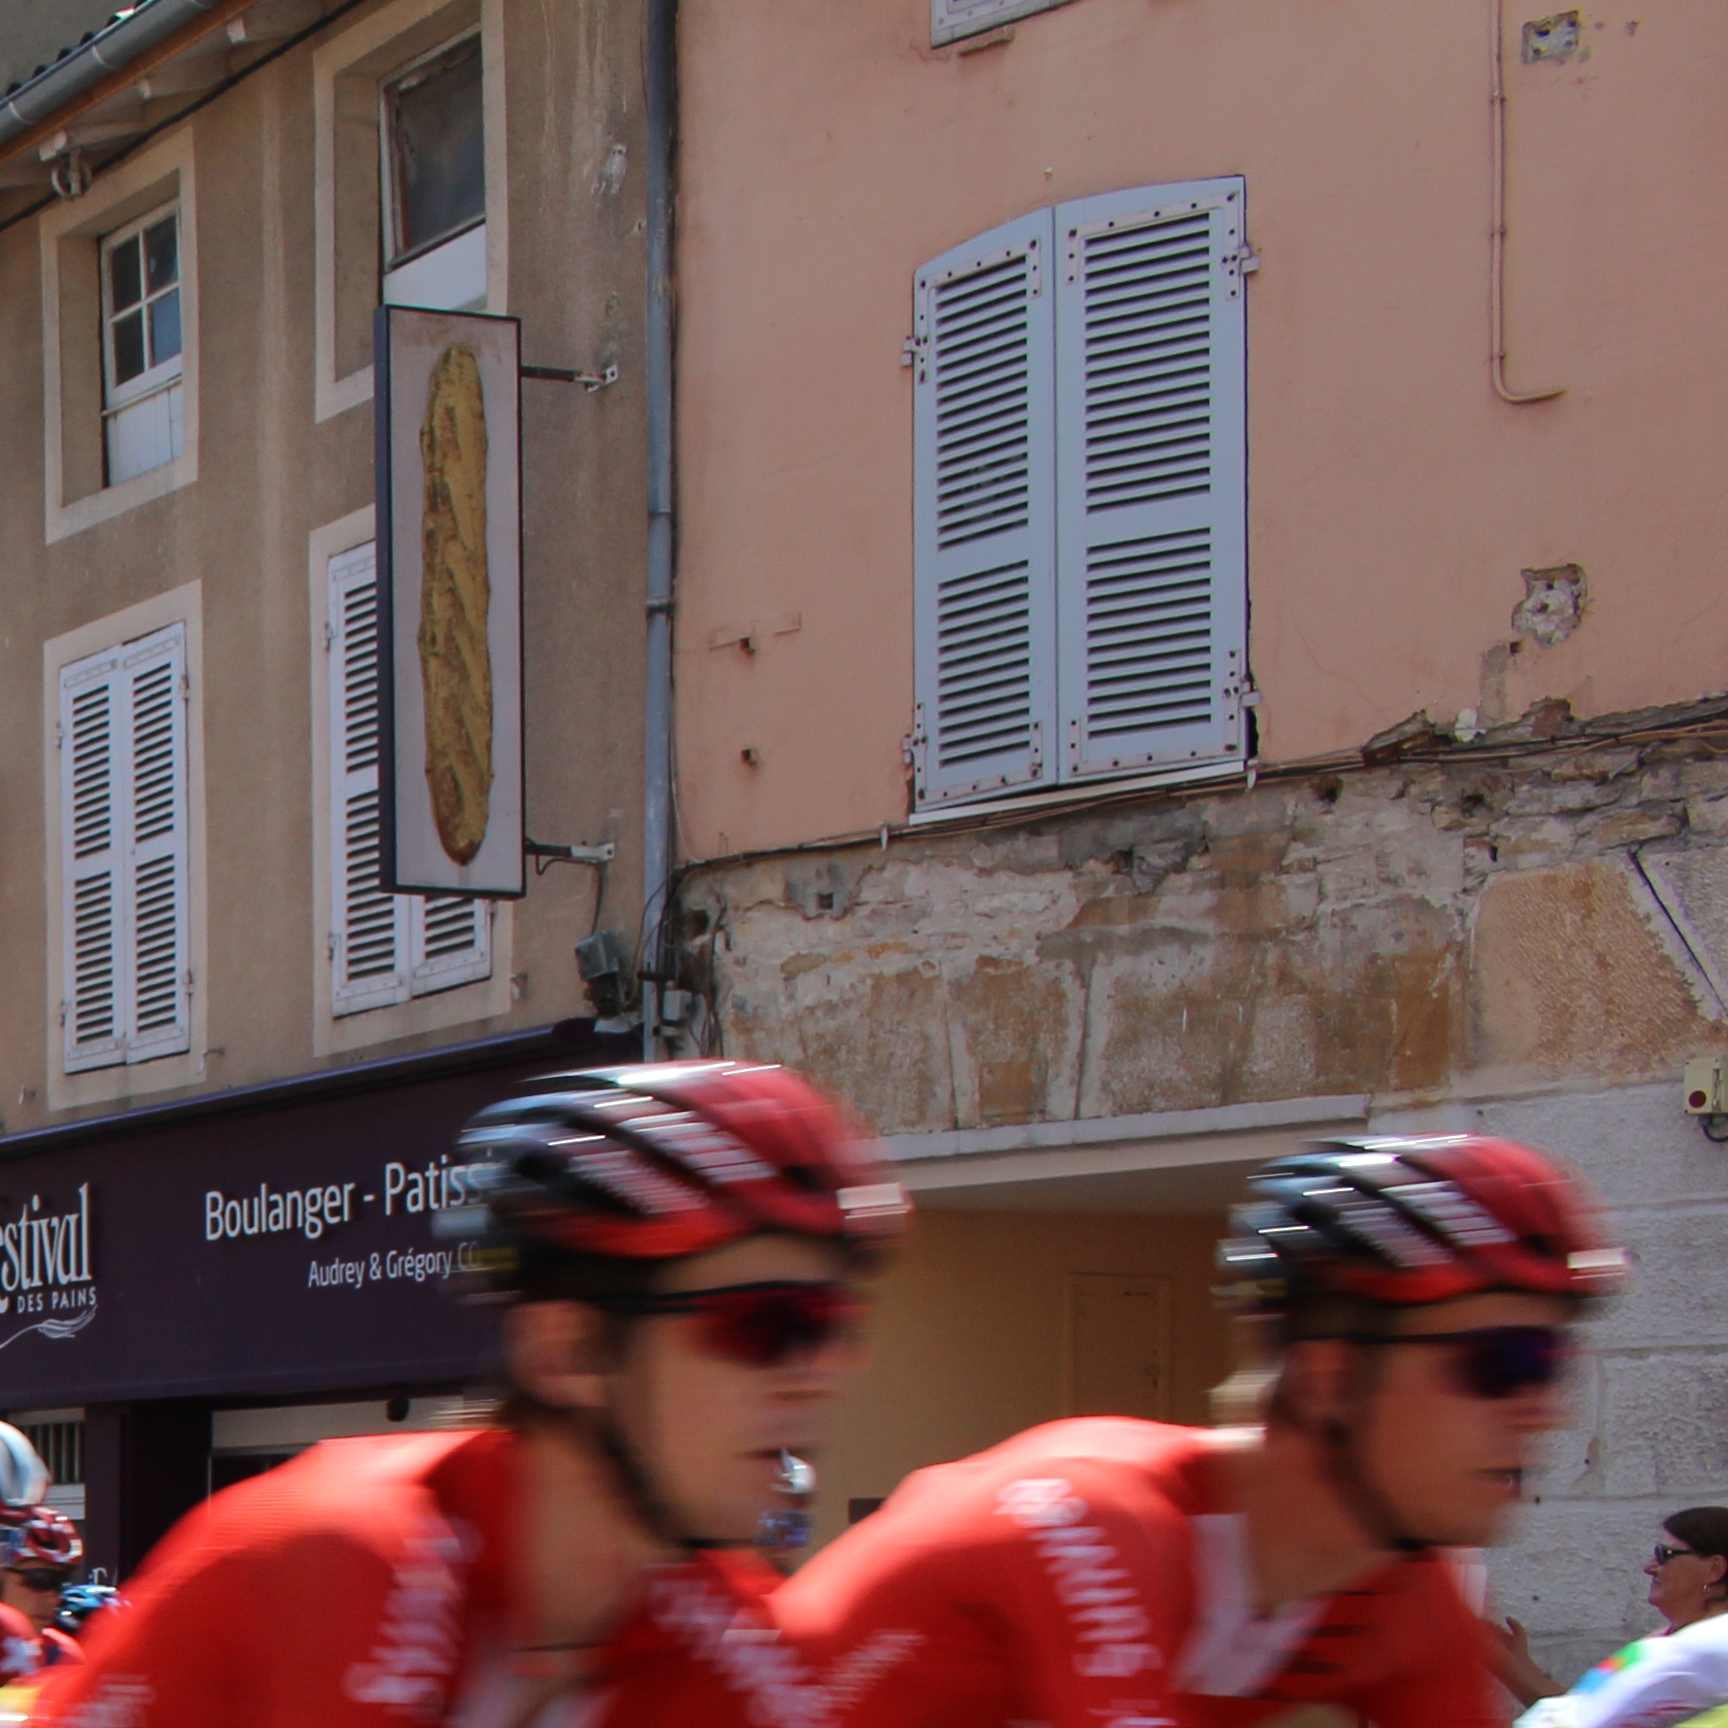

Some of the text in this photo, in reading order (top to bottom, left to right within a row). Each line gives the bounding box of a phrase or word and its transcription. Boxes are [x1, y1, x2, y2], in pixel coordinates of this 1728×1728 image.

[205, 1182, 355, 1240] Boulanger
[308, 1257, 364, 1288] Audrey
[369, 1252, 382, 1281] &
[386, 1247, 452, 1282] Grégory
[17, 1286, 97, 1314] DES PAINS
